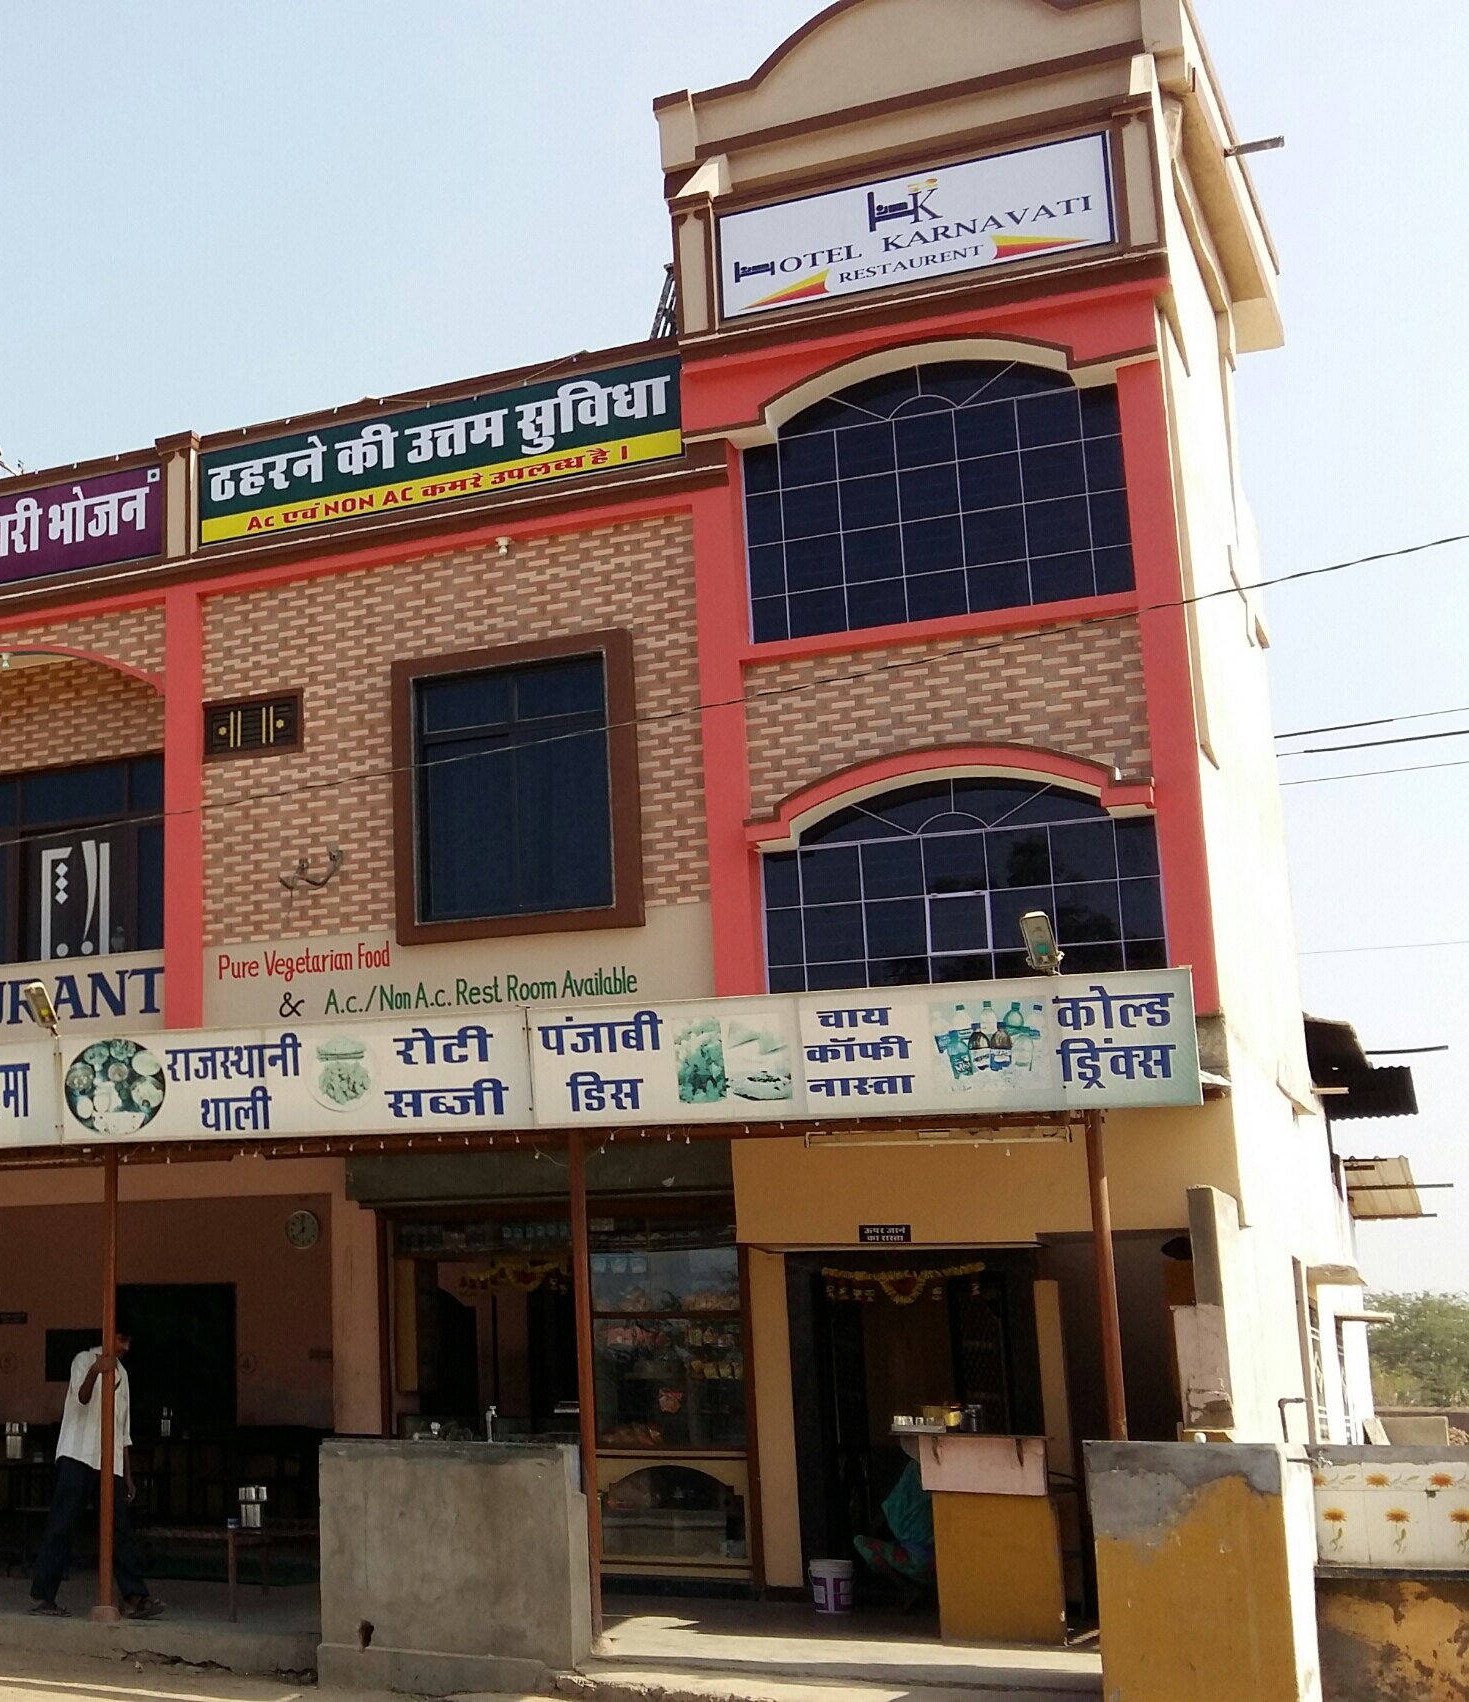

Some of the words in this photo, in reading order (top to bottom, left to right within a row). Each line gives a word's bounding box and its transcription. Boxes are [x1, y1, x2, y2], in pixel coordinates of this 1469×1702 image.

[882, 195, 1092, 253] KARNAVATI
[839, 244, 984, 283] RESTAURENT
[208, 436, 327, 502] ठहरने
[335, 423, 399, 475] की
[405, 408, 509, 460] उत्तम
[515, 375, 671, 455] सुविधा
[282, 502, 320, 524] एवं
[324, 494, 374, 516] NON
[382, 487, 413, 506] AC
[421, 473, 484, 497] कमरे
[489, 455, 585, 485] उपलब्ध
[586, 448, 610, 466] है
[47, 486, 150, 545] भोजन
[218, 954, 259, 980] Pure
[264, 947, 353, 982] Vegetarian
[358, 941, 390, 970] Food
[279, 992, 305, 1018] &
[456, 976, 503, 1006] Rest
[507, 974, 557, 1002] Room
[561, 966, 638, 998] Available
[1052, 986, 1174, 1030] कोल्ड
[537, 1010, 663, 1056] पंजाबी
[816, 1007, 893, 1029] चाय
[164, 1032, 302, 1082] राजस्थानी
[392, 1025, 494, 1066] रोटी
[804, 1035, 913, 1064] कॉफी
[1056, 1037, 1176, 1089] ड्रिंक्स
[384, 1078, 509, 1118] सब्जी
[566, 1071, 643, 1112] डिस
[807, 1074, 915, 1097] नास्ता
[200, 1085, 272, 1132] थाली
